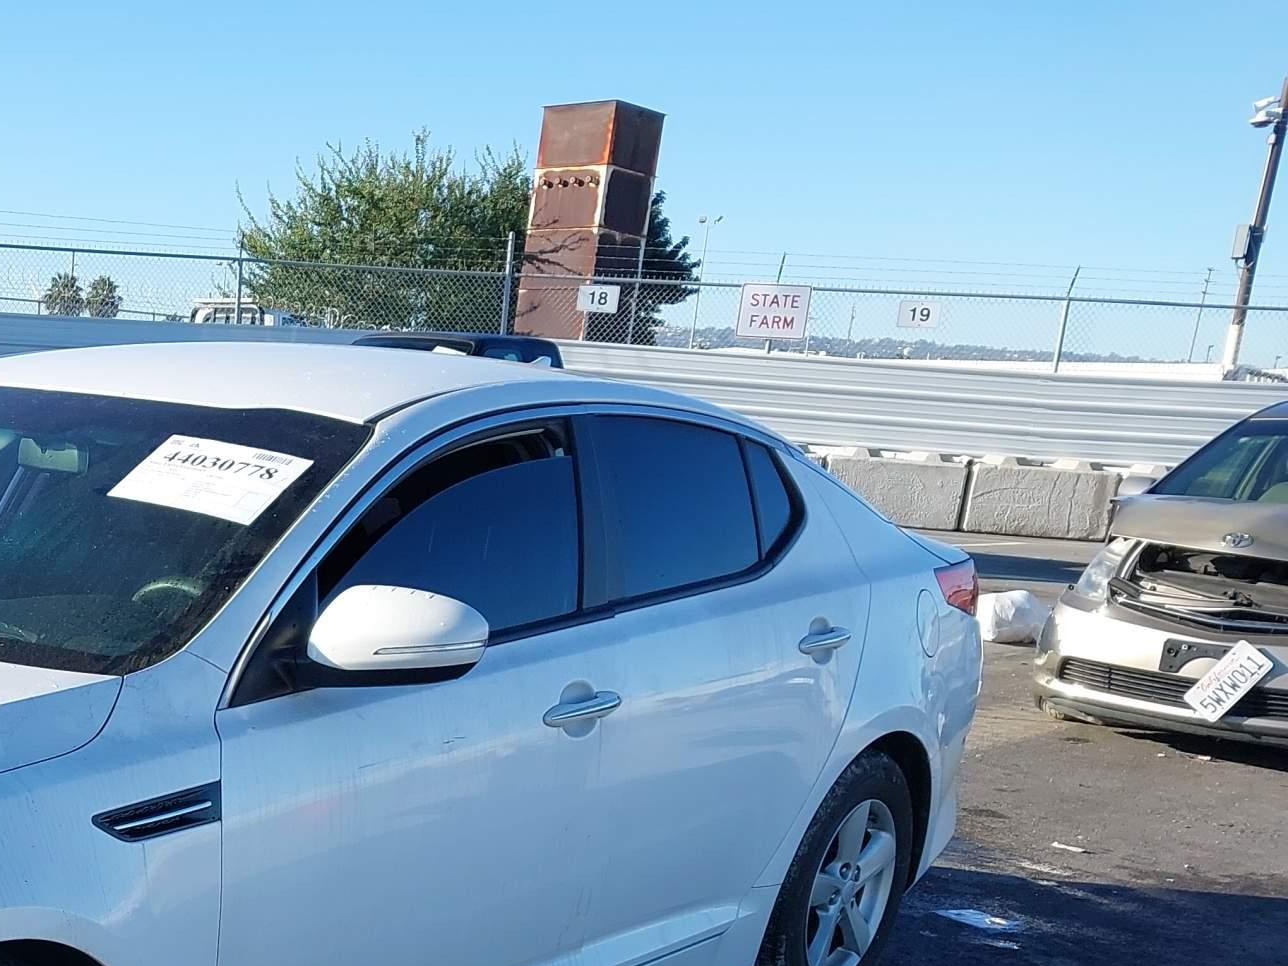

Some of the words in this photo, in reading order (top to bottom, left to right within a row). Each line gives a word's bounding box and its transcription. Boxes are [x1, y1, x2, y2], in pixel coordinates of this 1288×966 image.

[589, 291, 609, 306] 18
[750, 293, 801, 309] STATE
[749, 314, 795, 330] FARM
[909, 306, 931, 322] 19
[163, 450, 279, 480] 44030778
[1199, 656, 1264, 714] 5WXW011
